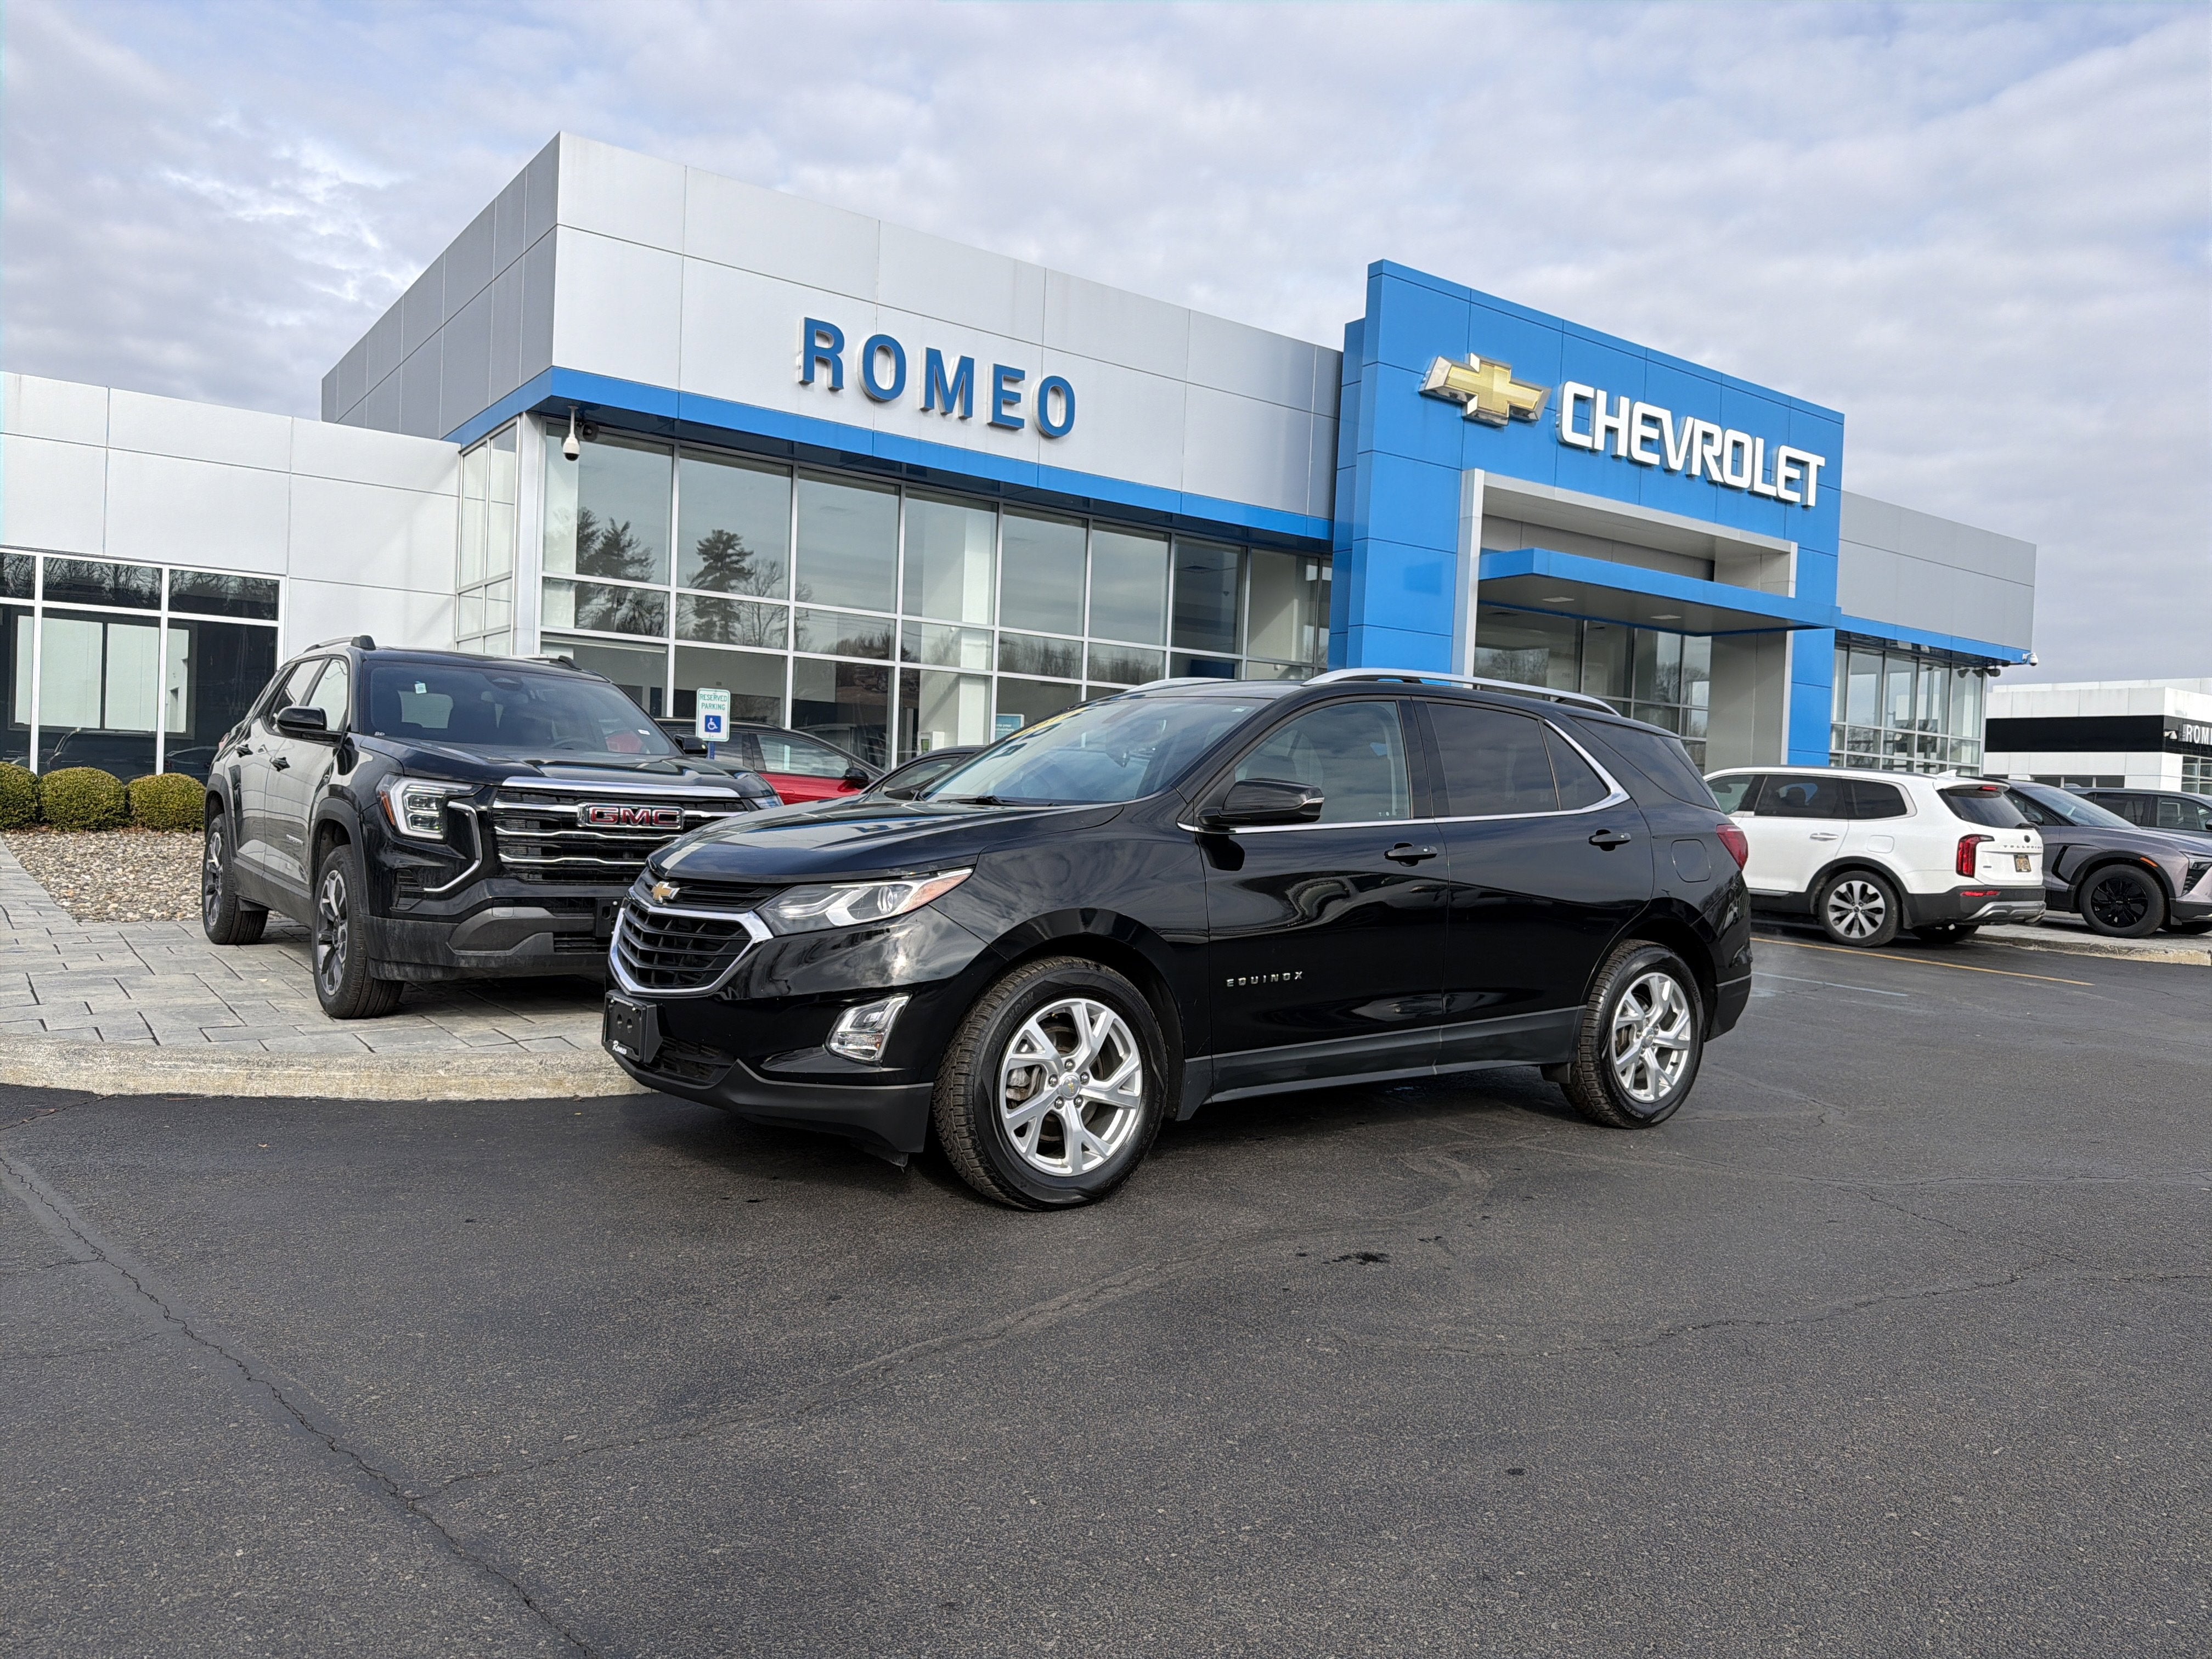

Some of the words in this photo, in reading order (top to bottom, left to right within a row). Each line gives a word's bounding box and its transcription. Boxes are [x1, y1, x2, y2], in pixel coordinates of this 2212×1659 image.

[799, 317, 1075, 437] ROMEO
[1558, 381, 1825, 507] CHEVROLET
[699, 693, 727, 702] RESERVED
[701, 702, 725, 711] PARKING
[2185, 724, 2212, 746] ROM
[589, 806, 680, 826] GMC
[1226, 970, 1303, 988] EQUINOX
